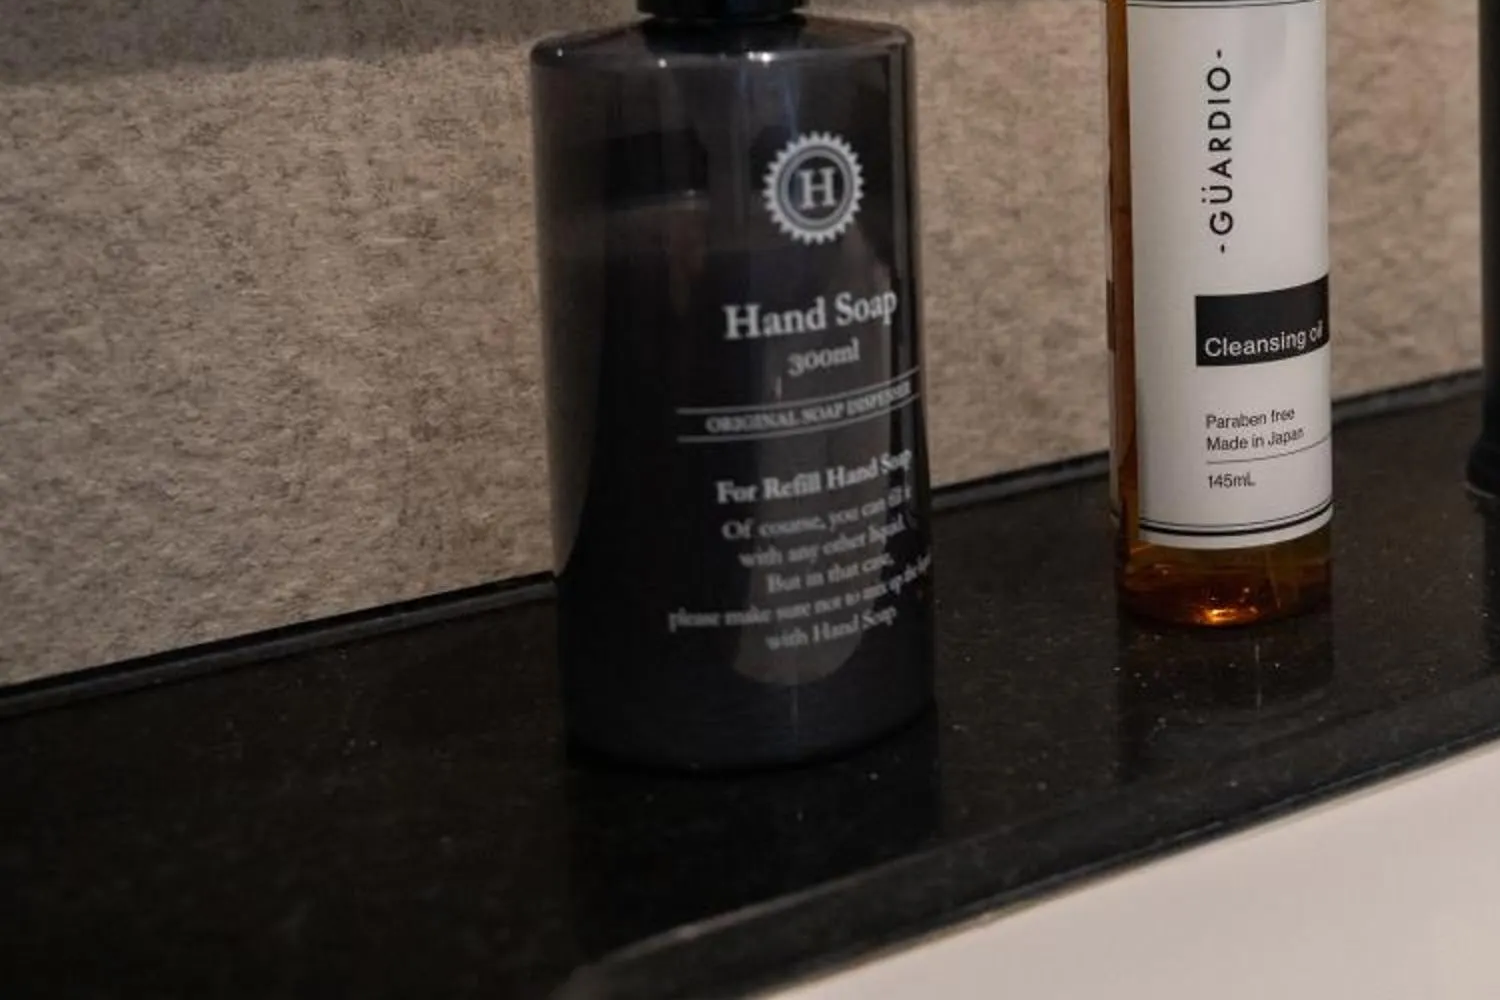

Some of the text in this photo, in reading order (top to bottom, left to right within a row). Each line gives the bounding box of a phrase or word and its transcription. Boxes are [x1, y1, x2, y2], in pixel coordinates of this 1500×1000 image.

[798, 166, 837, 210] H
[722, 289, 898, 340] Hand Soap
[787, 337, 861, 378] 300ml
[1204, 330, 1306, 358] Cleansing
[705, 410, 798, 434] ORIGINAL
[800, 402, 844, 424] SOAP
[1205, 407, 1296, 430] Paraben free
[1206, 426, 1305, 452] Made in Japan
[714, 479, 758, 505] For
[761, 470, 821, 501] Refill
[826, 457, 878, 490] Hand
[1207, 471, 1256, 490] 145mL
[720, 518, 752, 541] Of
[828, 506, 859, 533] you
[861, 496, 885, 518] can
[738, 544, 783, 568] with
[787, 543, 819, 564] any
[766, 572, 801, 594] But
[805, 568, 825, 588] in
[827, 560, 860, 583] that
[667, 605, 721, 634] please
[724, 603, 772, 627] make
[765, 628, 808, 651] with
[812, 614, 859, 644] Hand
